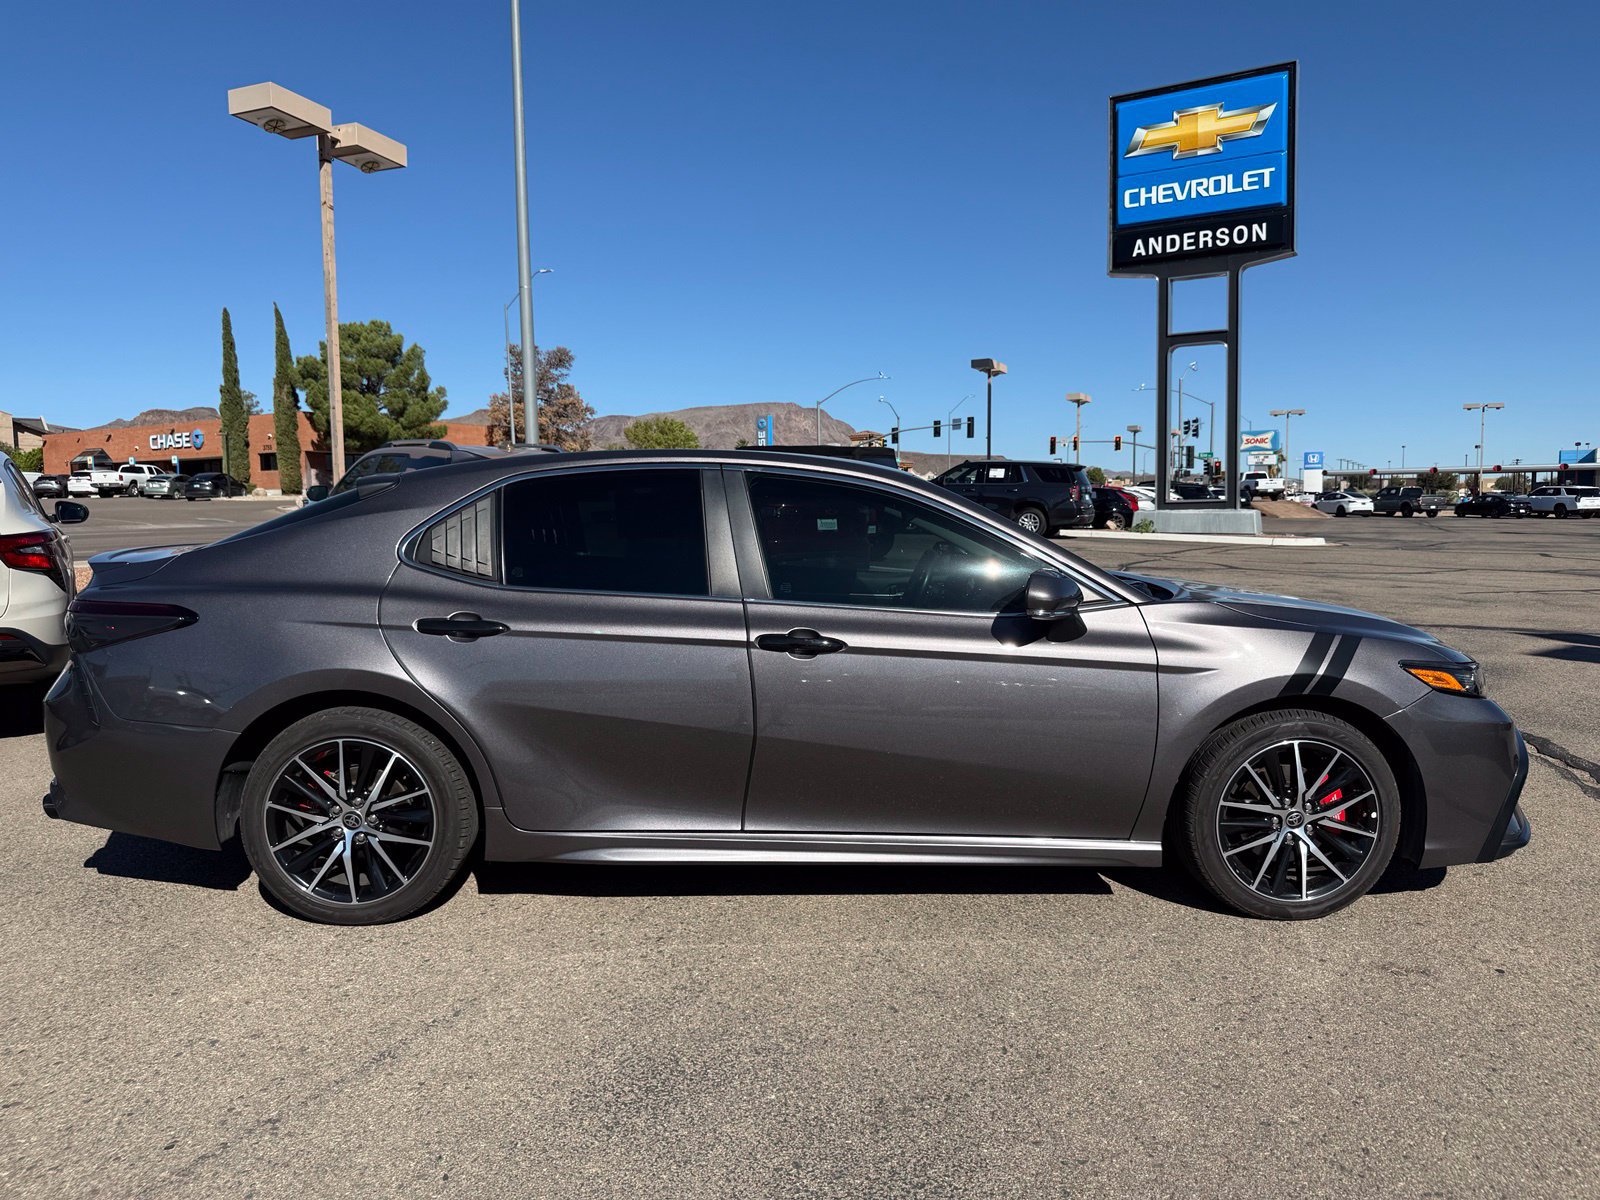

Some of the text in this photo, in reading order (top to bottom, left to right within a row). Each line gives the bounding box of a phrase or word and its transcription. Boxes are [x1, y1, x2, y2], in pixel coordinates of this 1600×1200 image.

[1123, 167, 1275, 209] CHEVROLET
[1132, 222, 1267, 257] ANDERSON
[149, 432, 191, 449] CHASE
